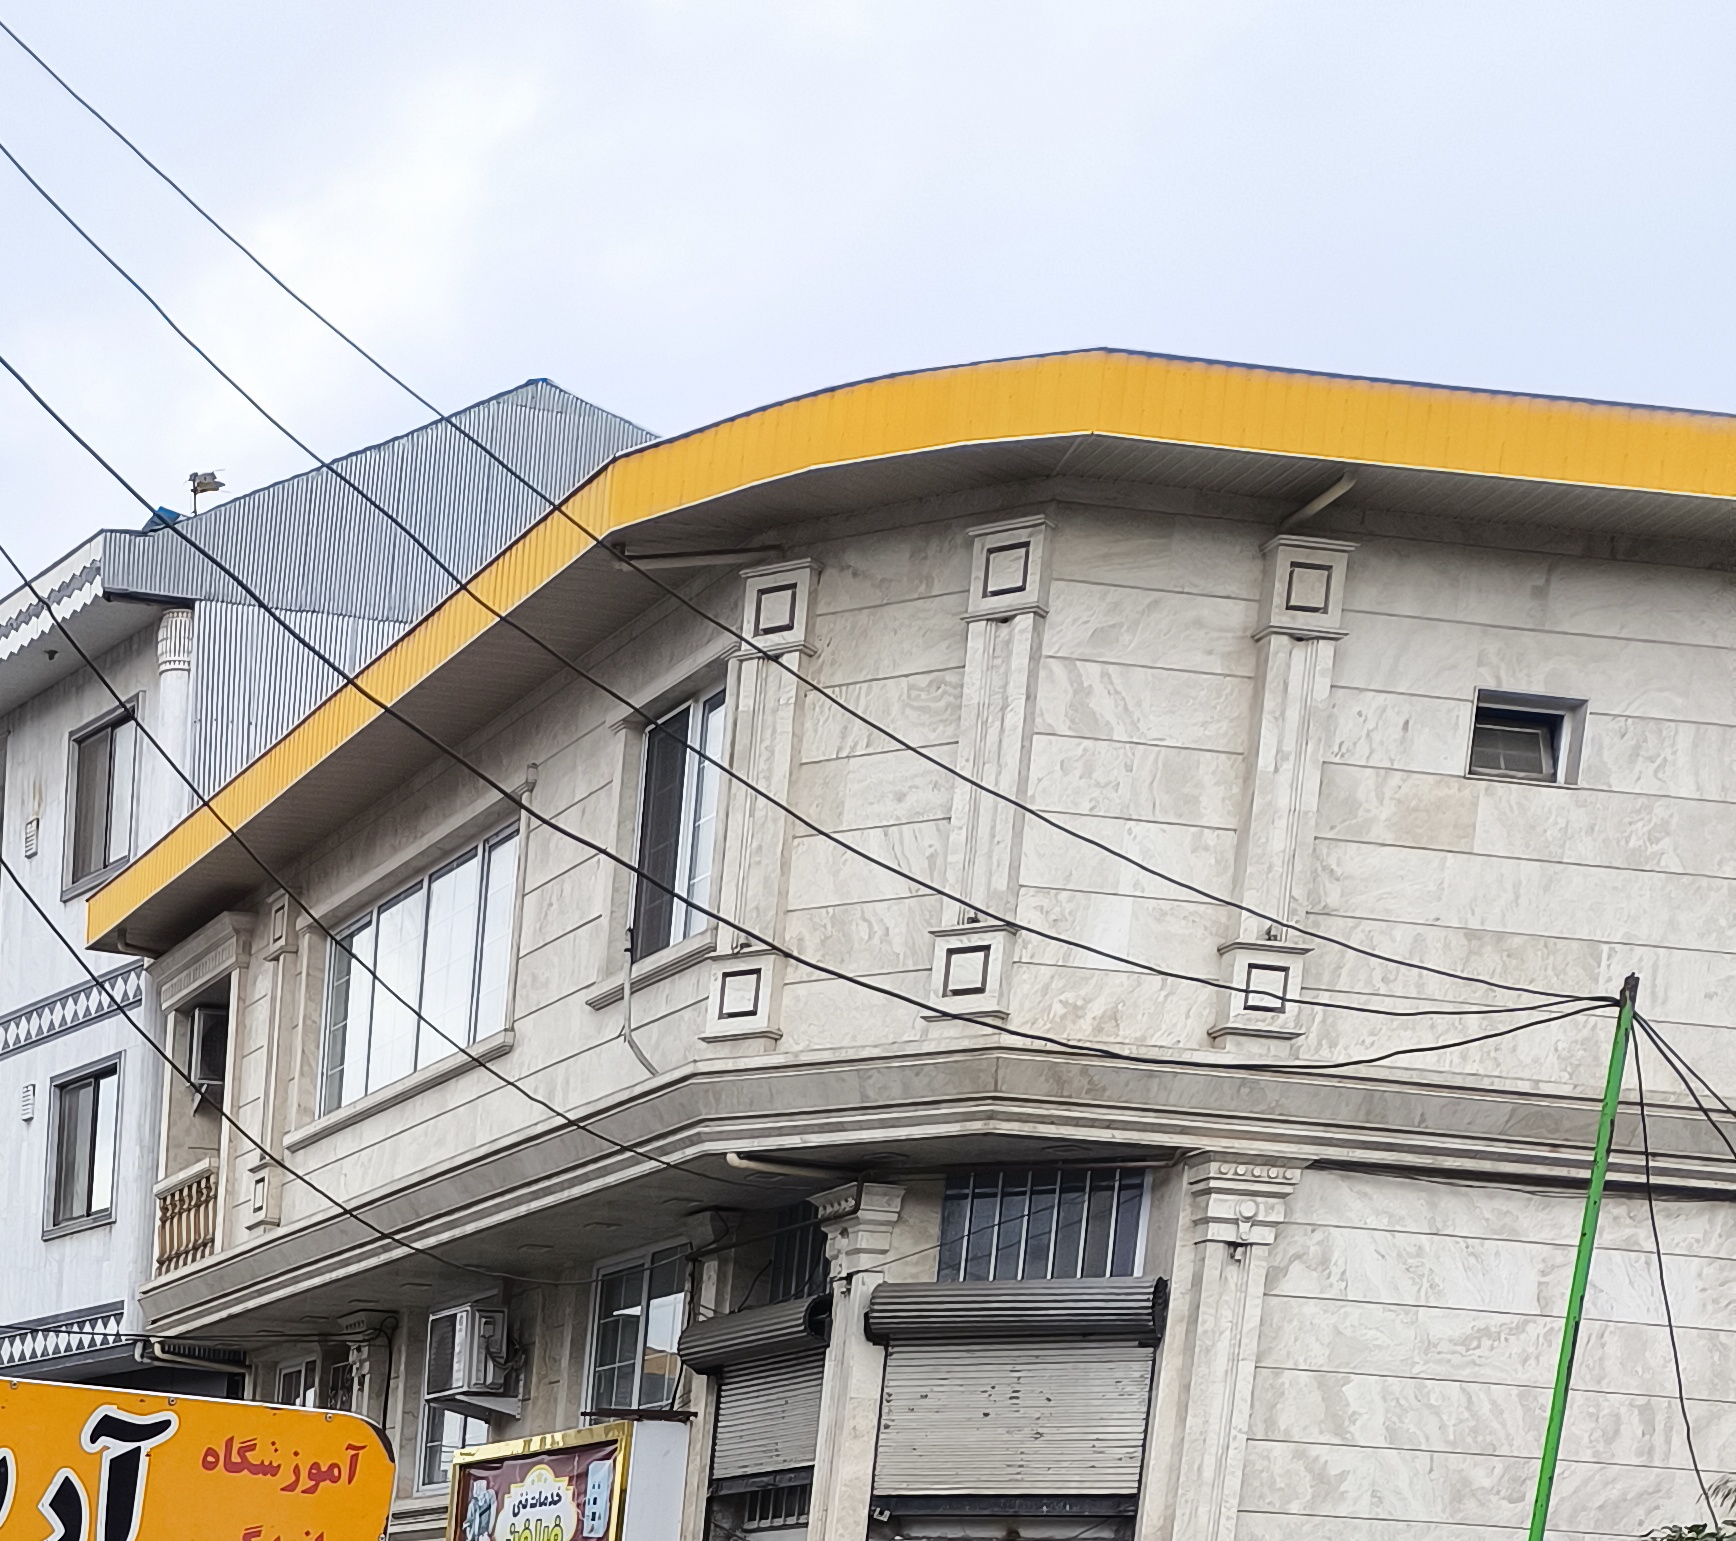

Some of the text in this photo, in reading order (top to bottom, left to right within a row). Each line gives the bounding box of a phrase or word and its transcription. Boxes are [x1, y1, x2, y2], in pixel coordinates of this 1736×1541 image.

[201, 1435, 368, 1495] آموزشگاه
[512, 1487, 563, 1518] خدمات فنی
